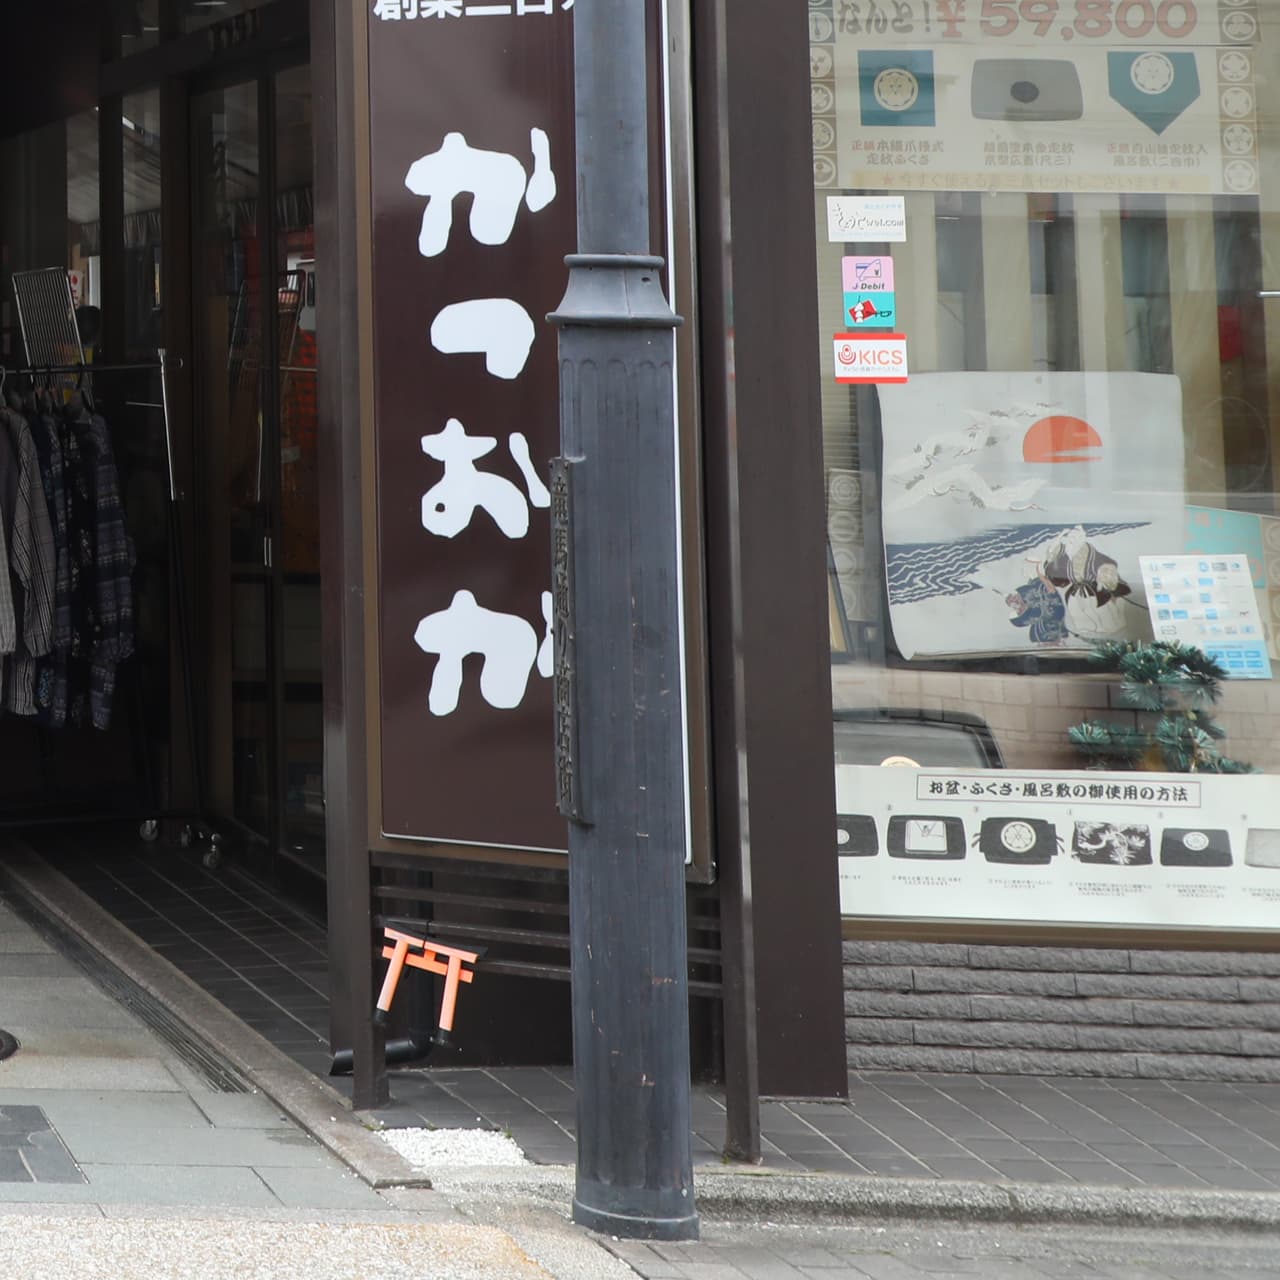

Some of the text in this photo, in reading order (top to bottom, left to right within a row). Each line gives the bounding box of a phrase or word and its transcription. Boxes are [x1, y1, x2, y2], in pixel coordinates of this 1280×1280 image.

[405, 128, 558, 716] かつおか
[859, 350, 903, 365] KICS
